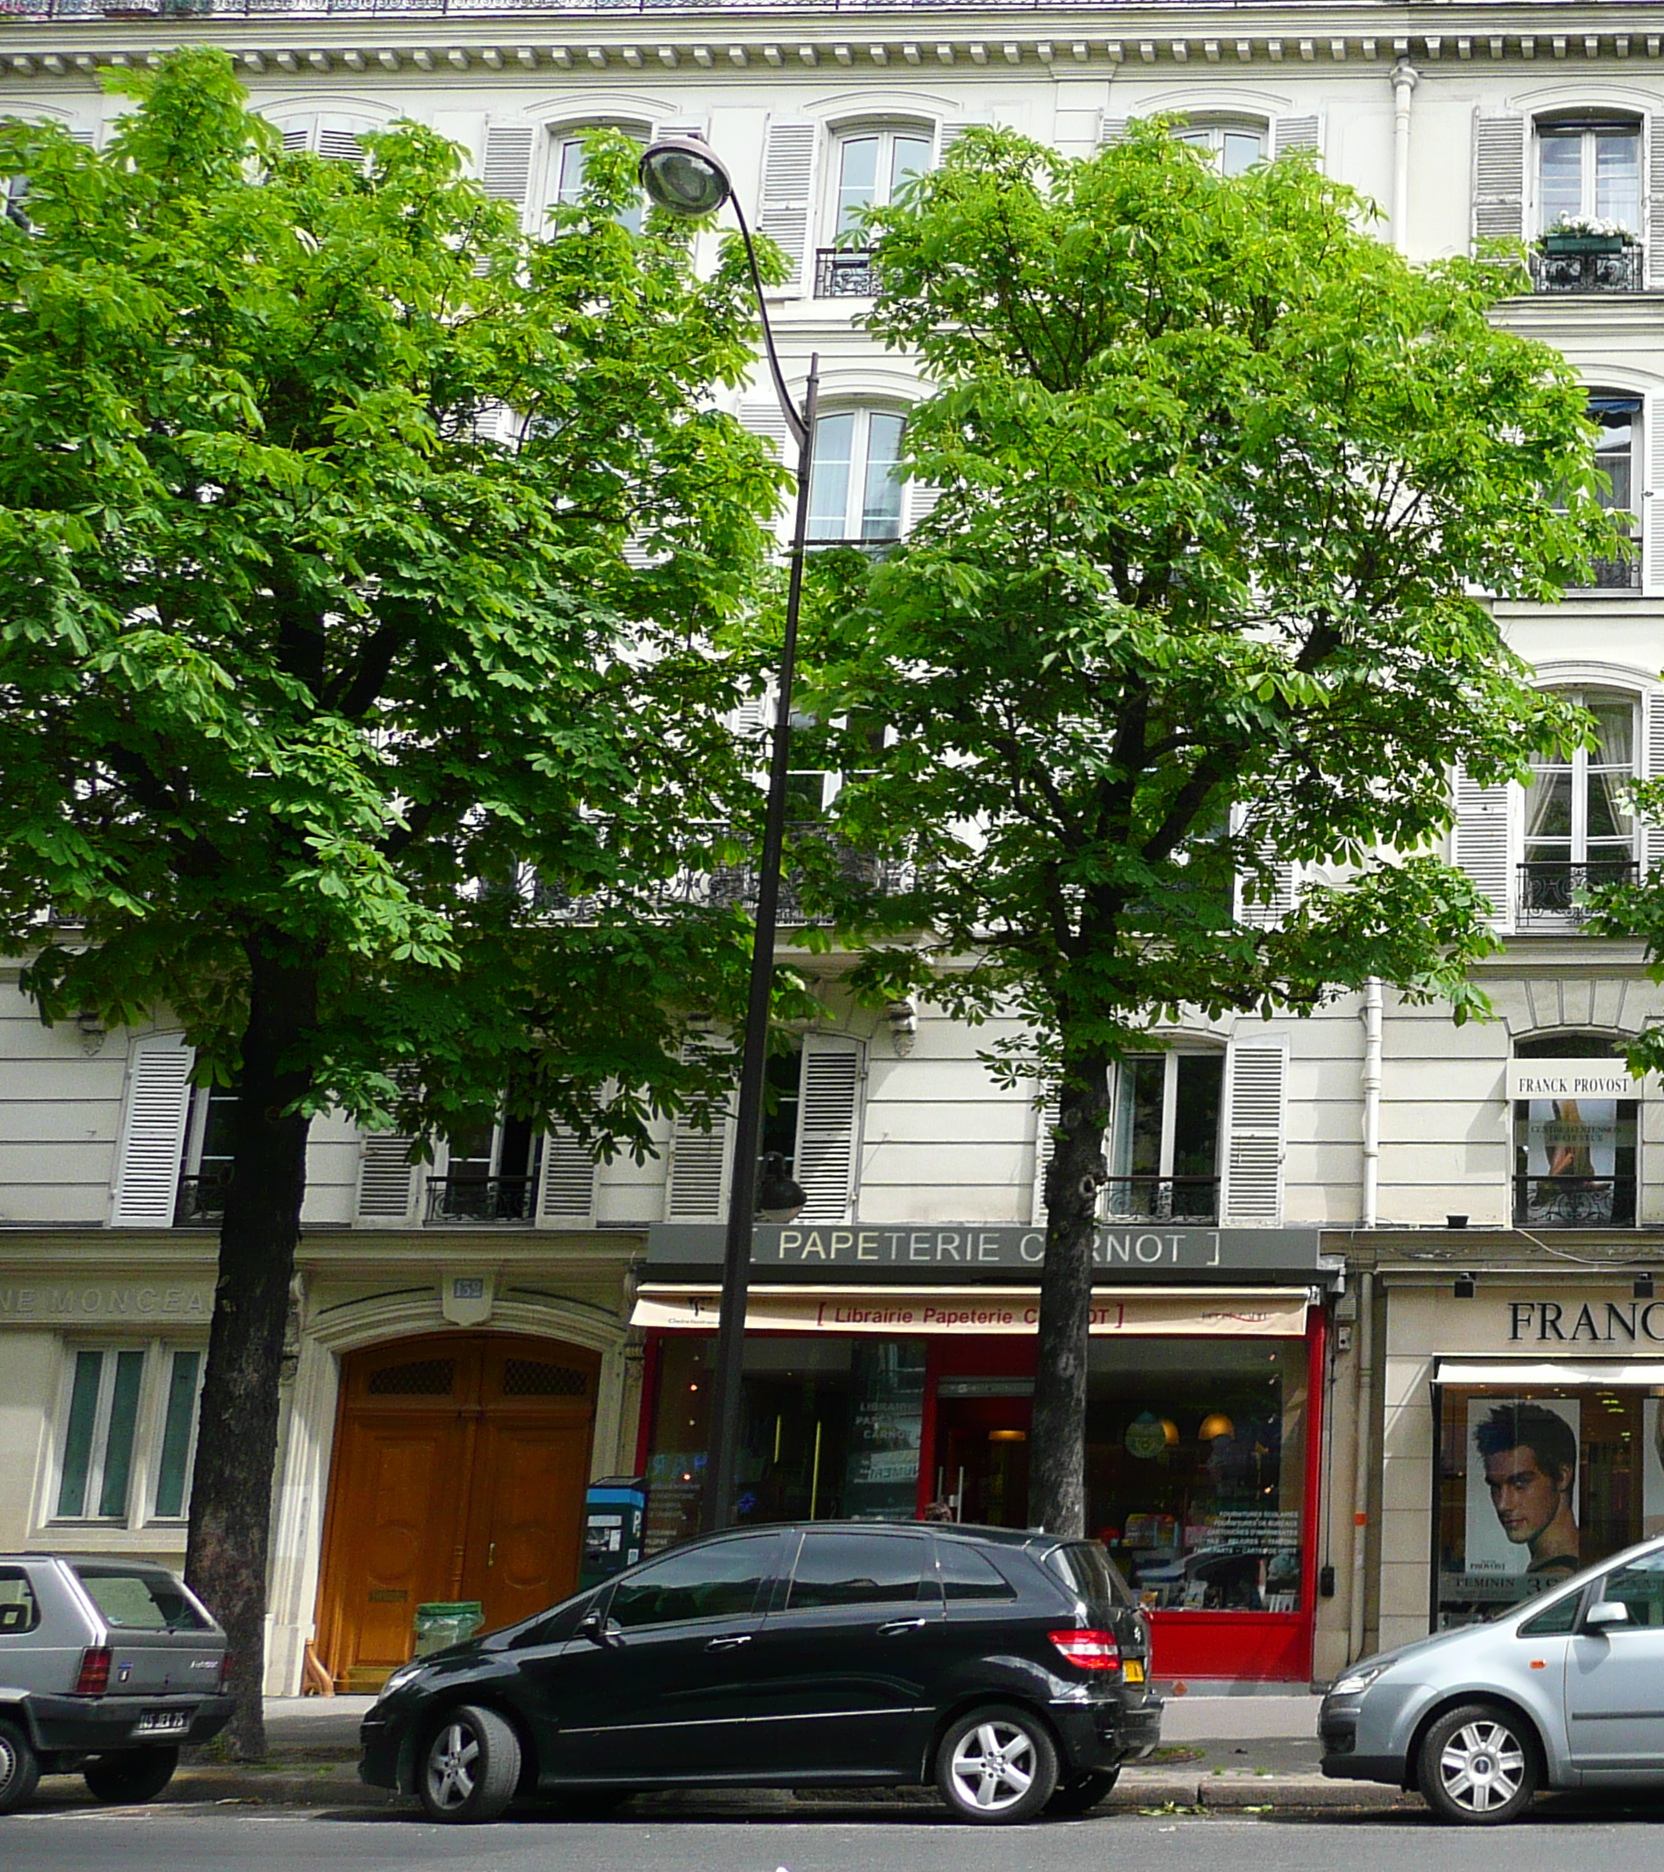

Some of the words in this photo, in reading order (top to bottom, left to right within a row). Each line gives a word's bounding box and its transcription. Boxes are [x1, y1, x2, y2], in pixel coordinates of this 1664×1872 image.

[1518, 1078, 1567, 1093] FRANCK
[1573, 1077, 1629, 1093] PROVOST
[779, 1231, 1001, 1261] PAPETERIE
[1019, 1233, 1187, 1263] CRNOT
[48, 1287, 216, 1313] MONCEA
[834, 1307, 913, 1323] Librairie
[922, 1308, 1012, 1328] Papeterie
